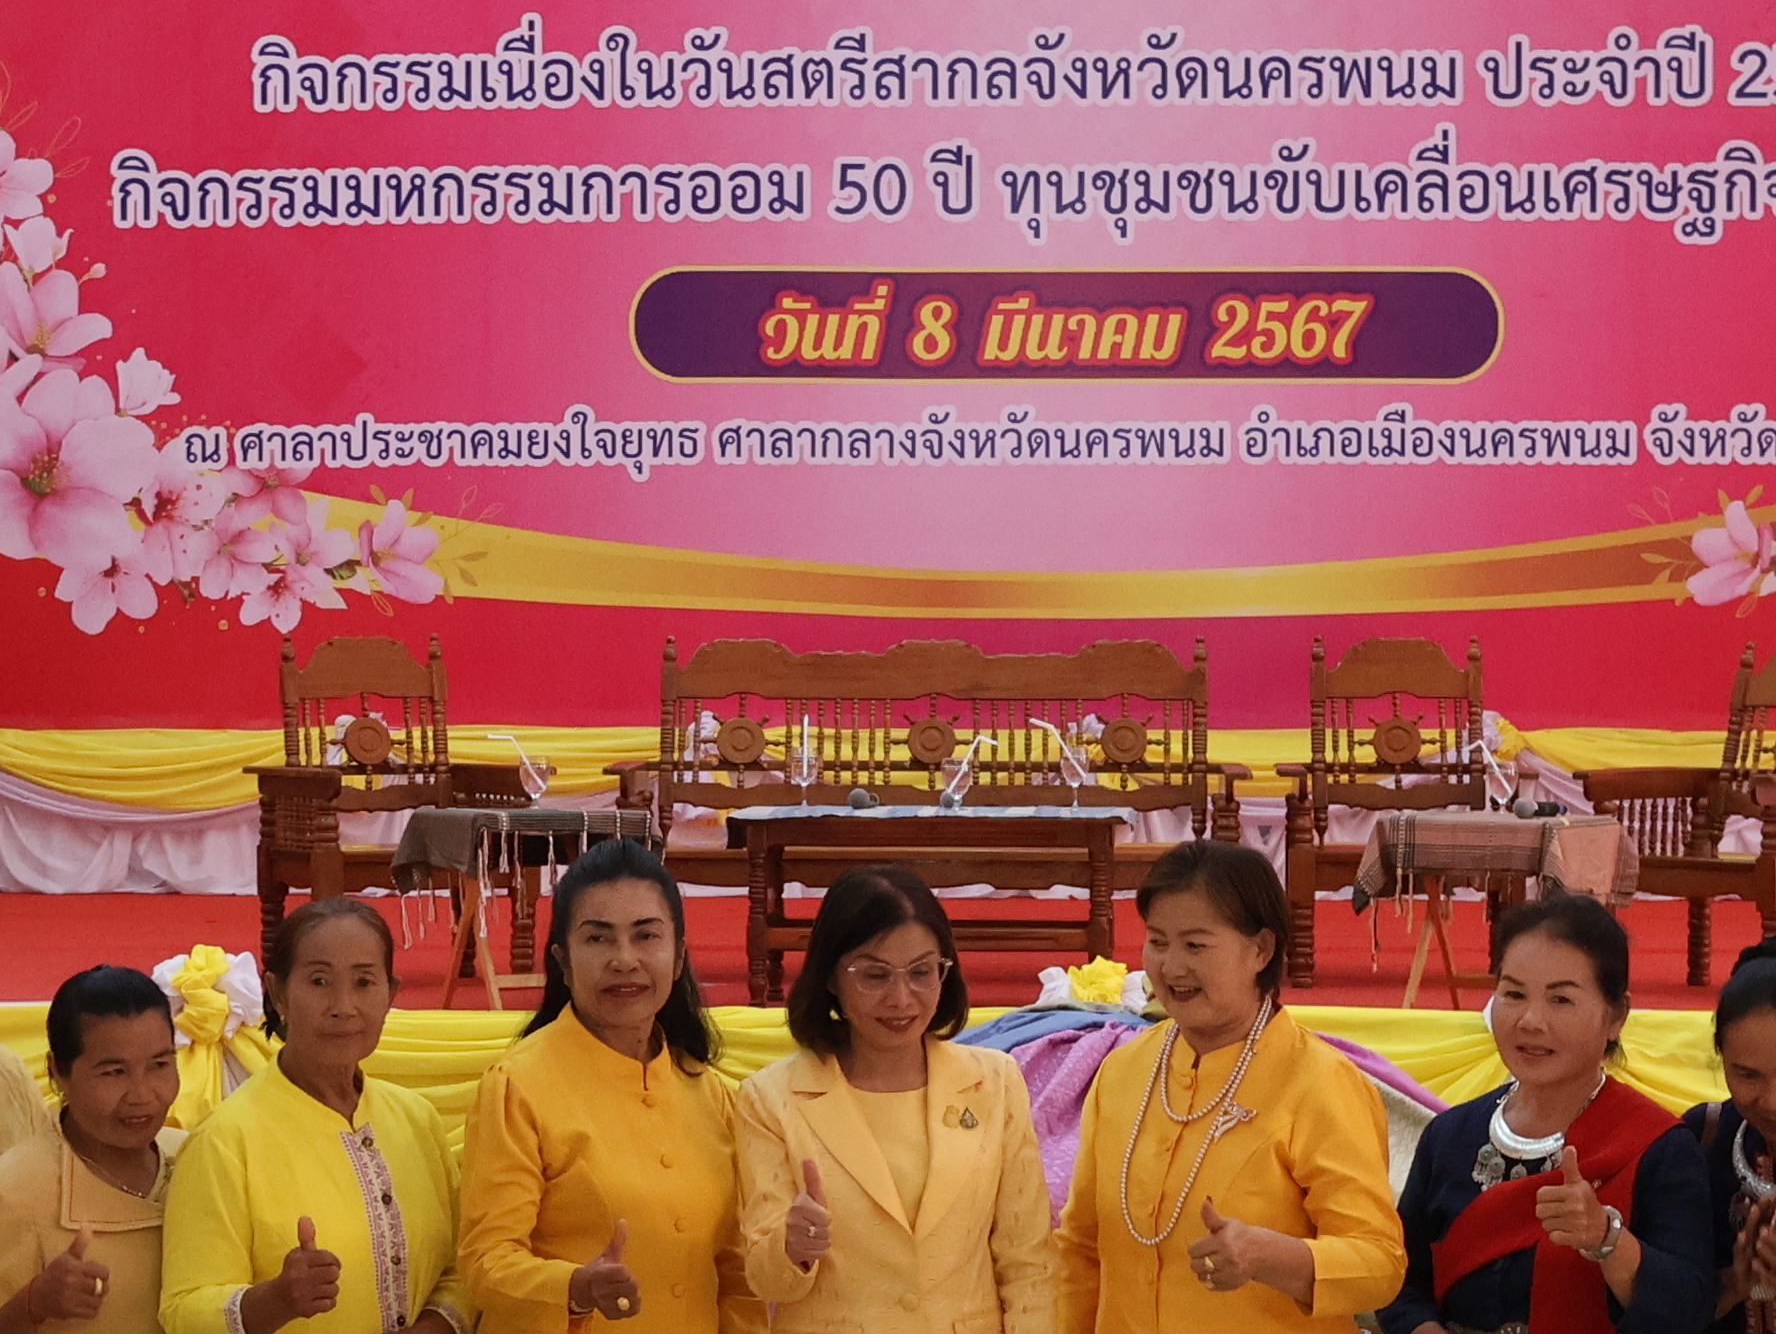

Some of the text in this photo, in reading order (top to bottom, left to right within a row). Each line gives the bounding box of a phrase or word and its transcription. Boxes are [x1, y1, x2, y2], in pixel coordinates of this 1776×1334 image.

[259, 19, 1455, 106] กิจกรรมเนื่องในวันสตรีสากลจังหวัดนครพนม
[1484, 29, 1706, 100] ประจำปี
[117, 156, 804, 222] กิจกรรมมหกรรมการออม
[834, 163, 908, 215] 50
[930, 144, 973, 215] ปี
[763, 284, 1369, 361] วันที่ 8 มีนาคม 2567
[184, 431, 221, 463] ณ
[240, 412, 699, 473] ศาลาประชาคมยงใจยุทธ
[718, 410, 1224, 460] ศาลากลางจังหวัดนครพนม
[1246, 409, 1630, 459] อำเภอเมืองนครพนม
